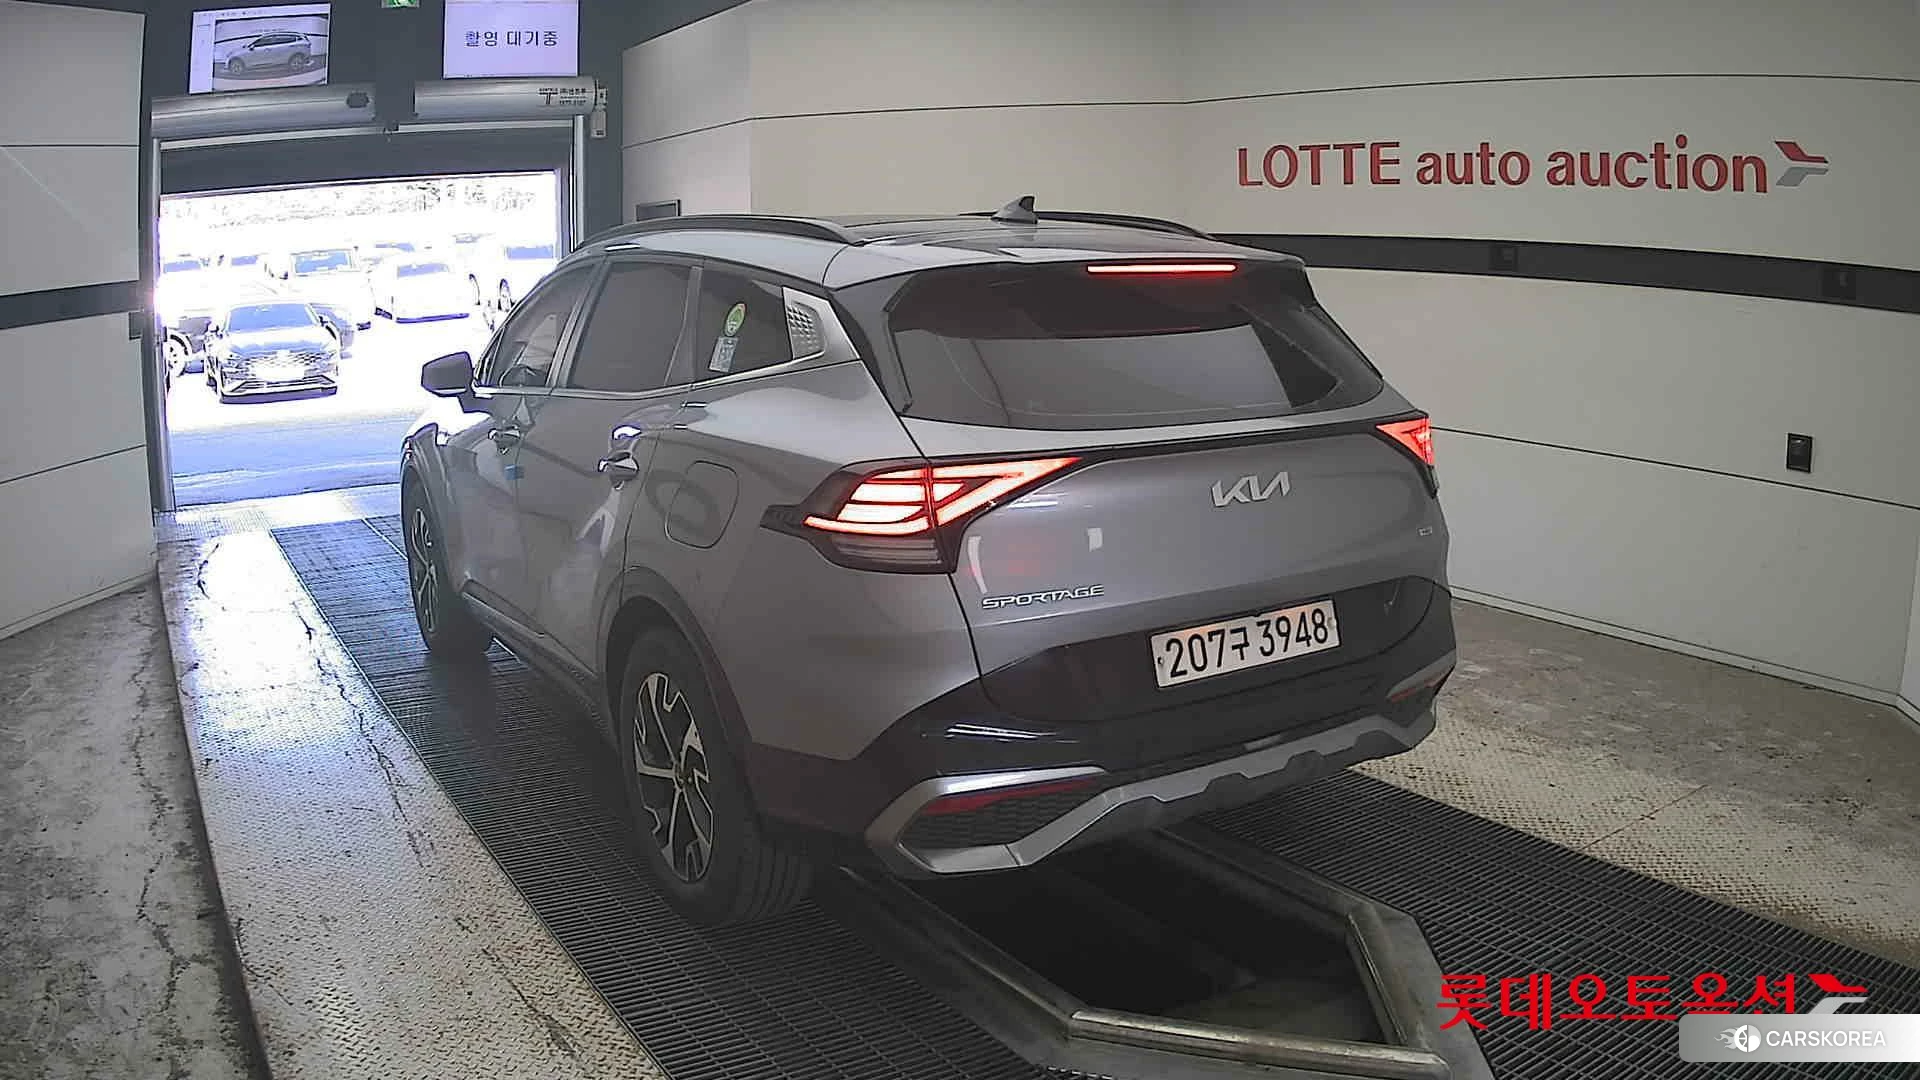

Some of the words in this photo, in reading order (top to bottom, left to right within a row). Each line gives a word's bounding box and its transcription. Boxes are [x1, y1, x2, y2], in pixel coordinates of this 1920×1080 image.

[506, 31, 558, 47] 대기중
[1236, 141, 1401, 188] LOTTE
[1416, 141, 1530, 186] auto
[1546, 135, 1768, 193] auction
[1212, 471, 1290, 507] KIA
[982, 584, 1104, 609] SPORTAGE
[1256, 607, 1328, 657] 3948
